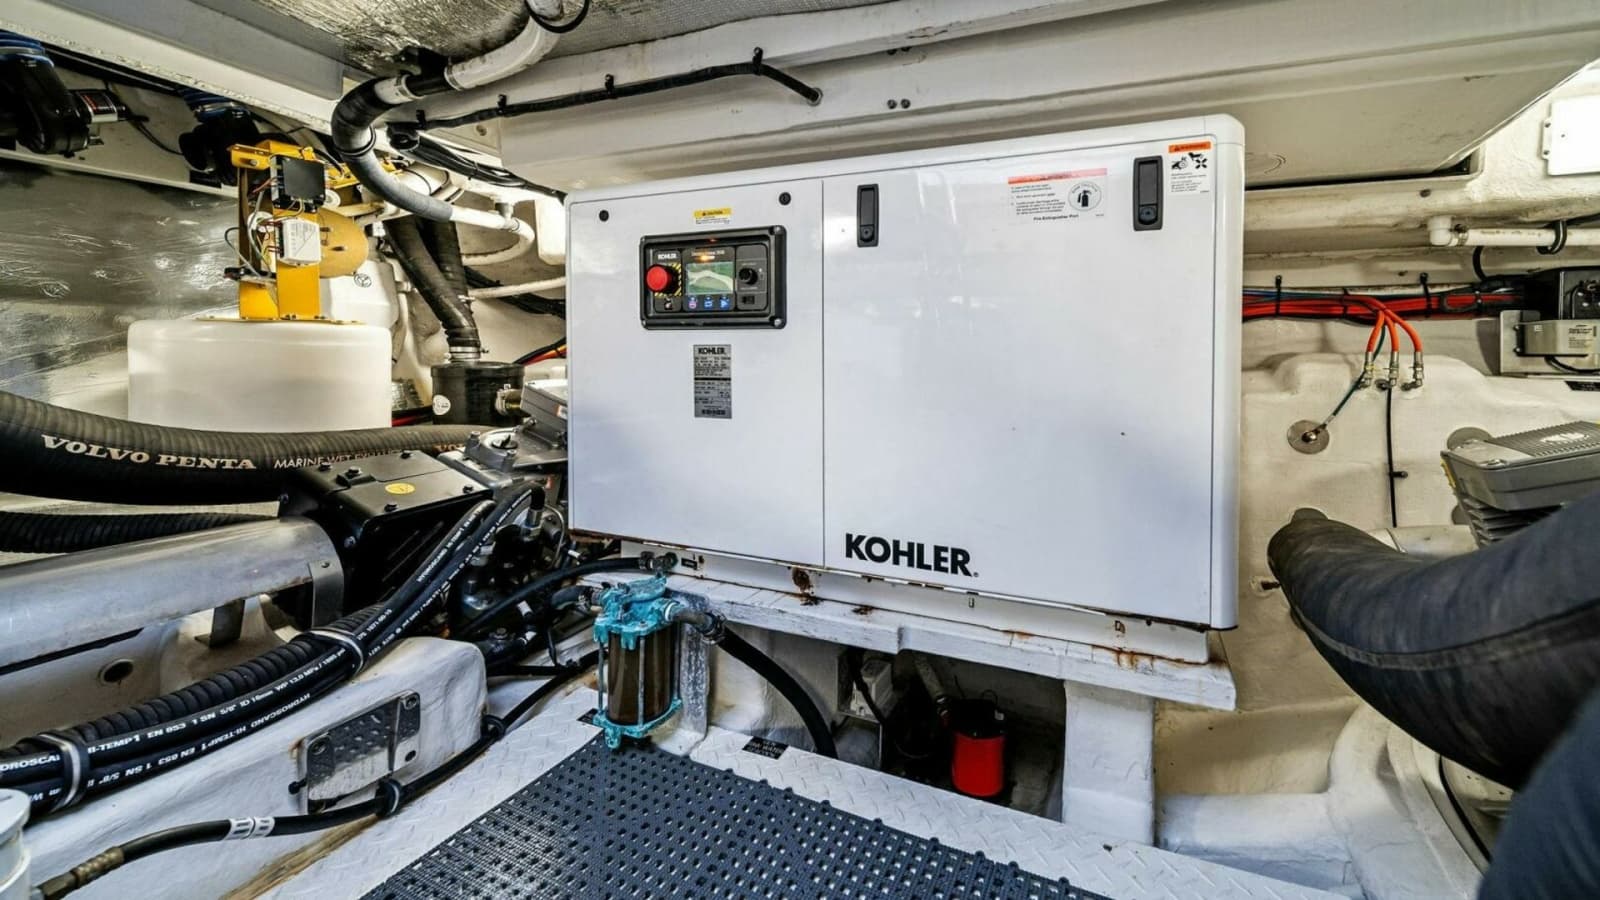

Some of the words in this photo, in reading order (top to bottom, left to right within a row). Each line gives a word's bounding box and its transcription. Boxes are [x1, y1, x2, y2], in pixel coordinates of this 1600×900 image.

[41, 434, 150, 464] VOLVO
[156, 454, 257, 470] PENTA
[846, 532, 972, 577] KOHLER
[251, 693, 310, 728] HYDROSCAND
[147, 729, 164, 738] EN
[166, 722, 186, 733] 853
[199, 711, 216, 721] SN
[201, 726, 246, 750] HI-TEMP1
[0, 754, 60, 771] DROSCA
[158, 754, 178, 765] 853
[180, 748, 196, 758] EN
[125, 765, 143, 776] SN
